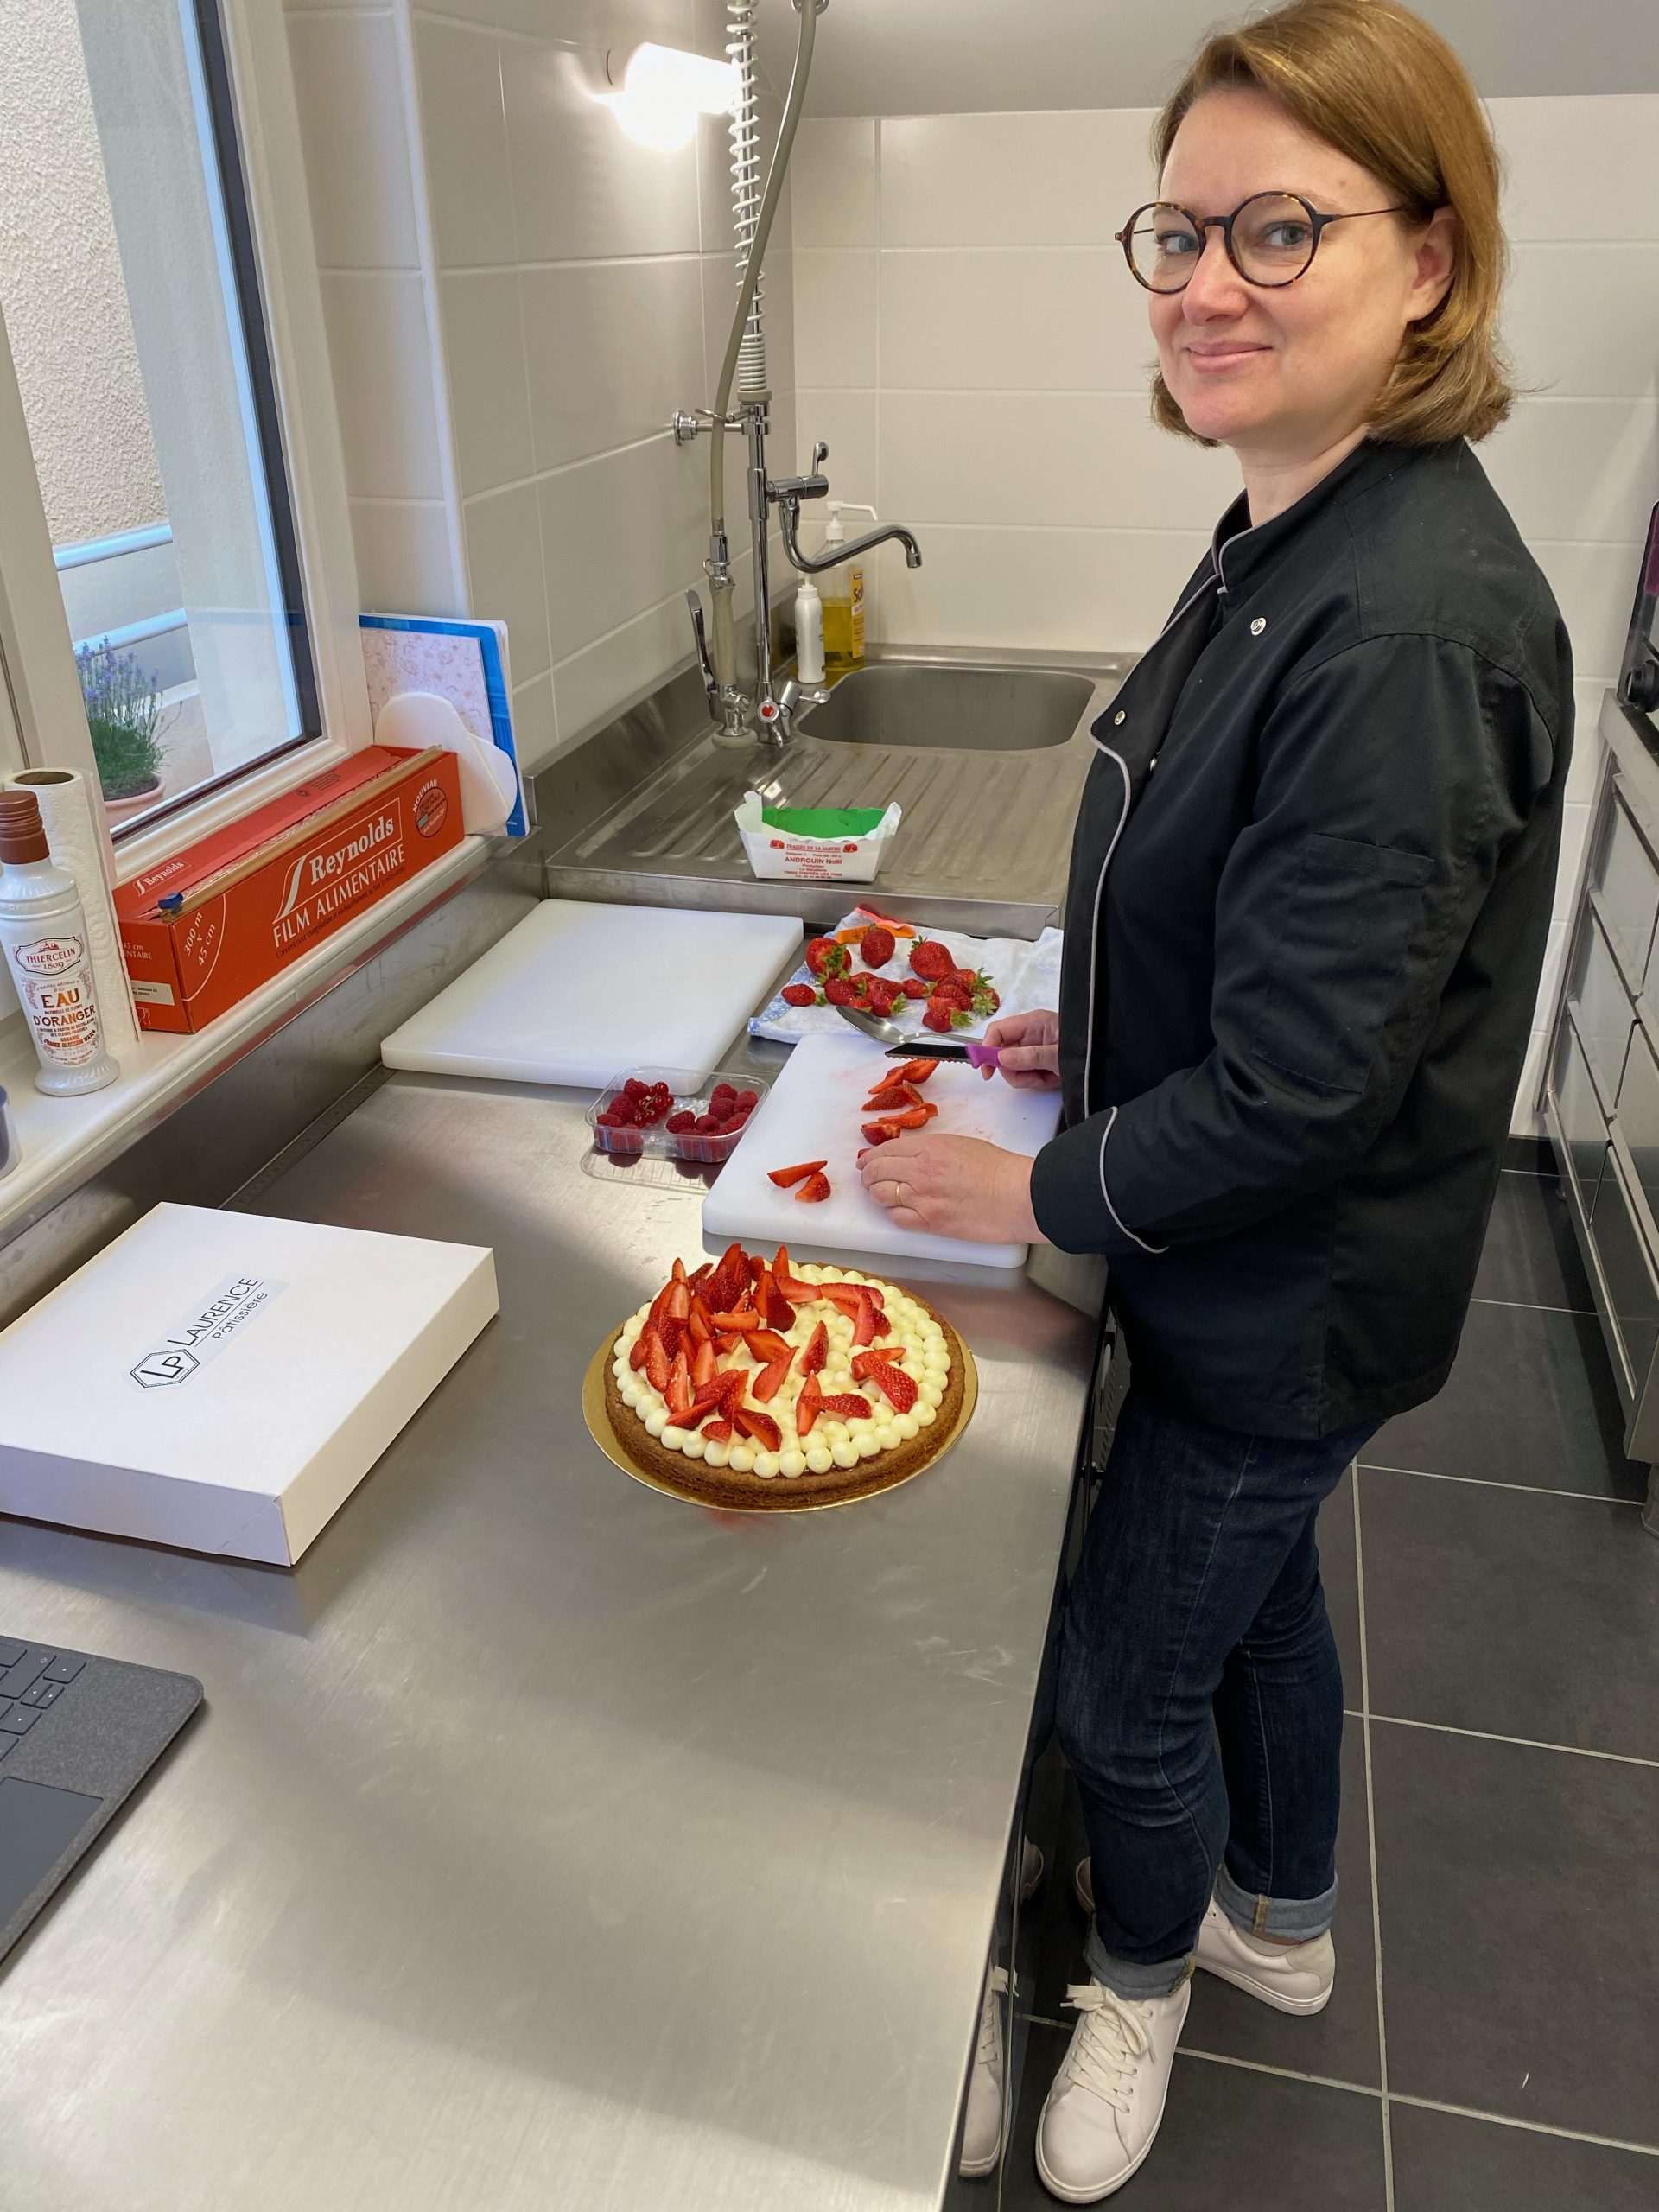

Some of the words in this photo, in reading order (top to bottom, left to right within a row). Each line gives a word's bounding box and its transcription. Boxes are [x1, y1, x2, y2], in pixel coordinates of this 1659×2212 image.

[412, 779, 438, 813] NOUVEAU
[309, 815, 395, 886] Reynolds
[143, 861, 185, 887] Reynolds
[273, 906, 311, 949] FILM
[316, 843, 406, 920] ALIMENTAIRE
[184, 928, 196, 957] 300
[194, 912, 203, 928] m
[198, 947, 207, 967] 45
[206, 924, 216, 946] cm
[26, 948, 76, 963] THIERCELIN
[44, 961, 65, 970] 1809
[41, 988, 80, 1009] EAU
[33, 1004, 96, 1027] D'ORANGER
[44, 1039, 60, 1047] ORANGE
[61, 1038, 84, 1048] BLOSSOM
[60, 1034, 80, 1043] ORGANIC
[167, 1278, 259, 1346] LAURENCE
[212, 1292, 268, 1340] Pâtissière
[140, 1356, 185, 1379] LP
